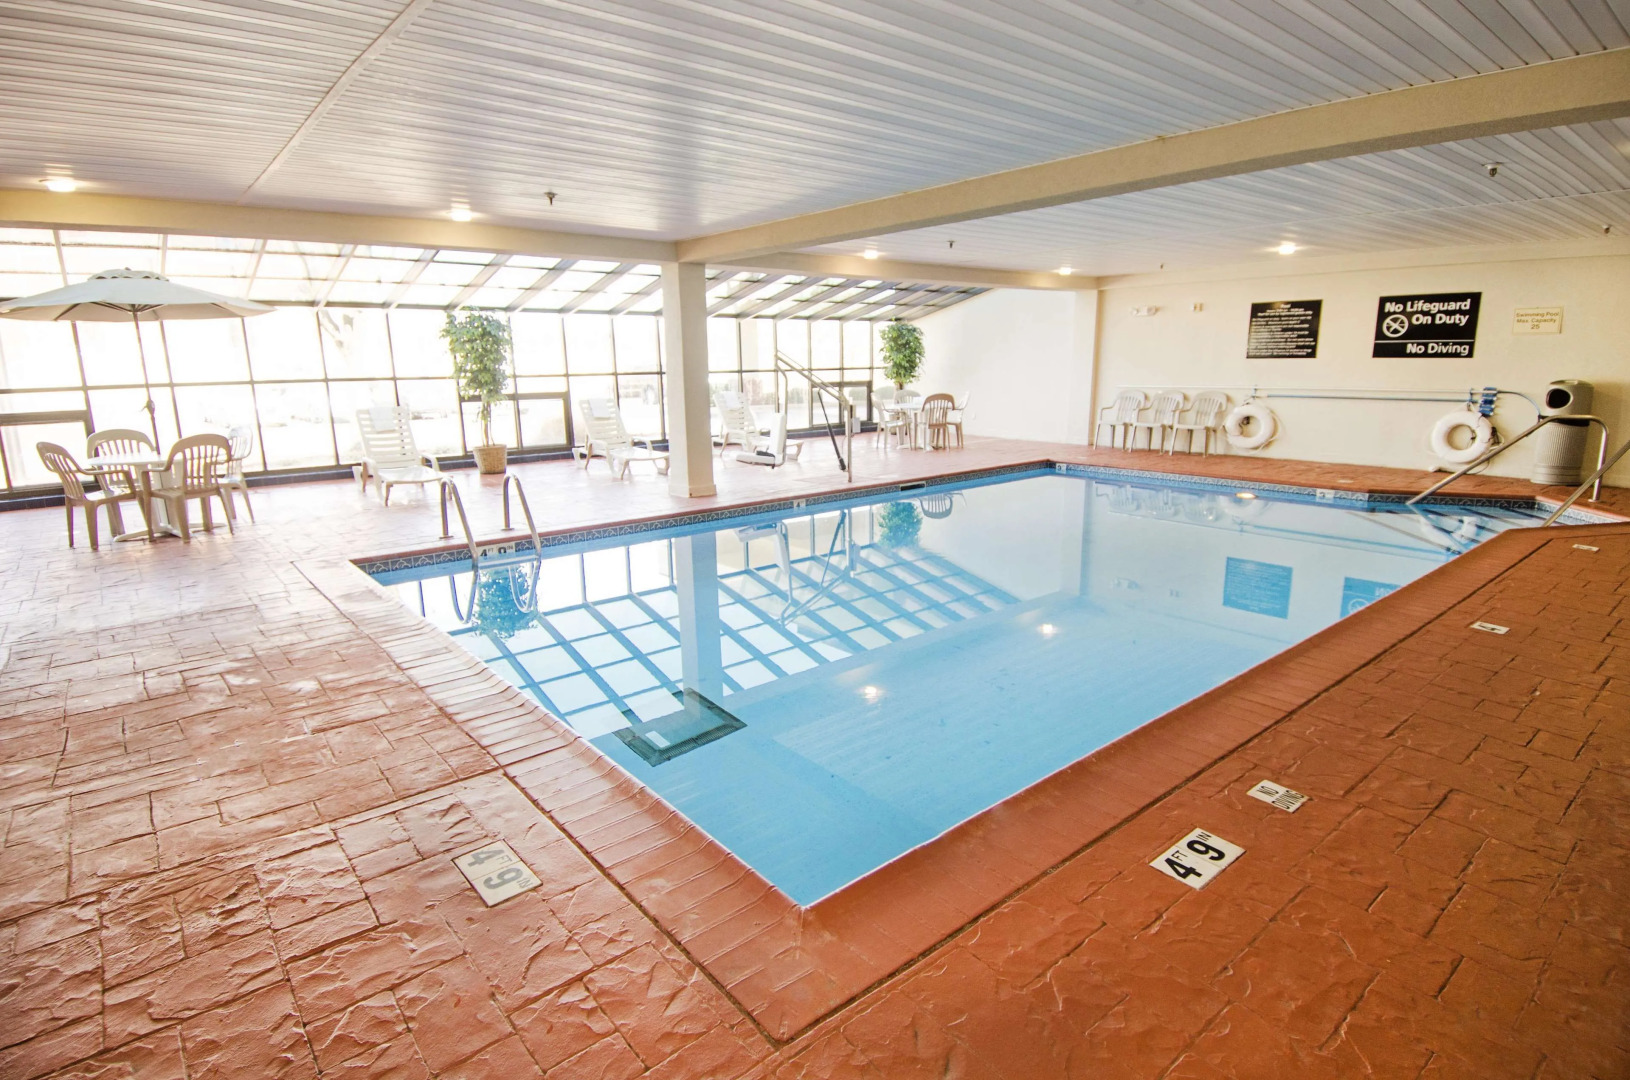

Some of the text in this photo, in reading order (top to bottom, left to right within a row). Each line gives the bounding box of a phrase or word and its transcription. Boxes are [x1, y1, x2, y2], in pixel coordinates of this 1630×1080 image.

[1384, 299, 1471, 314] No Lifeguard
[1411, 313, 1469, 326] On Duty
[1406, 342, 1470, 356] No Diving
[1257, 785, 1279, 797] NO
[1272, 790, 1304, 809] DIVING
[1164, 831, 1225, 879] 4 FT 9 IN
[468, 849, 533, 890] 4 FT 9 IN
